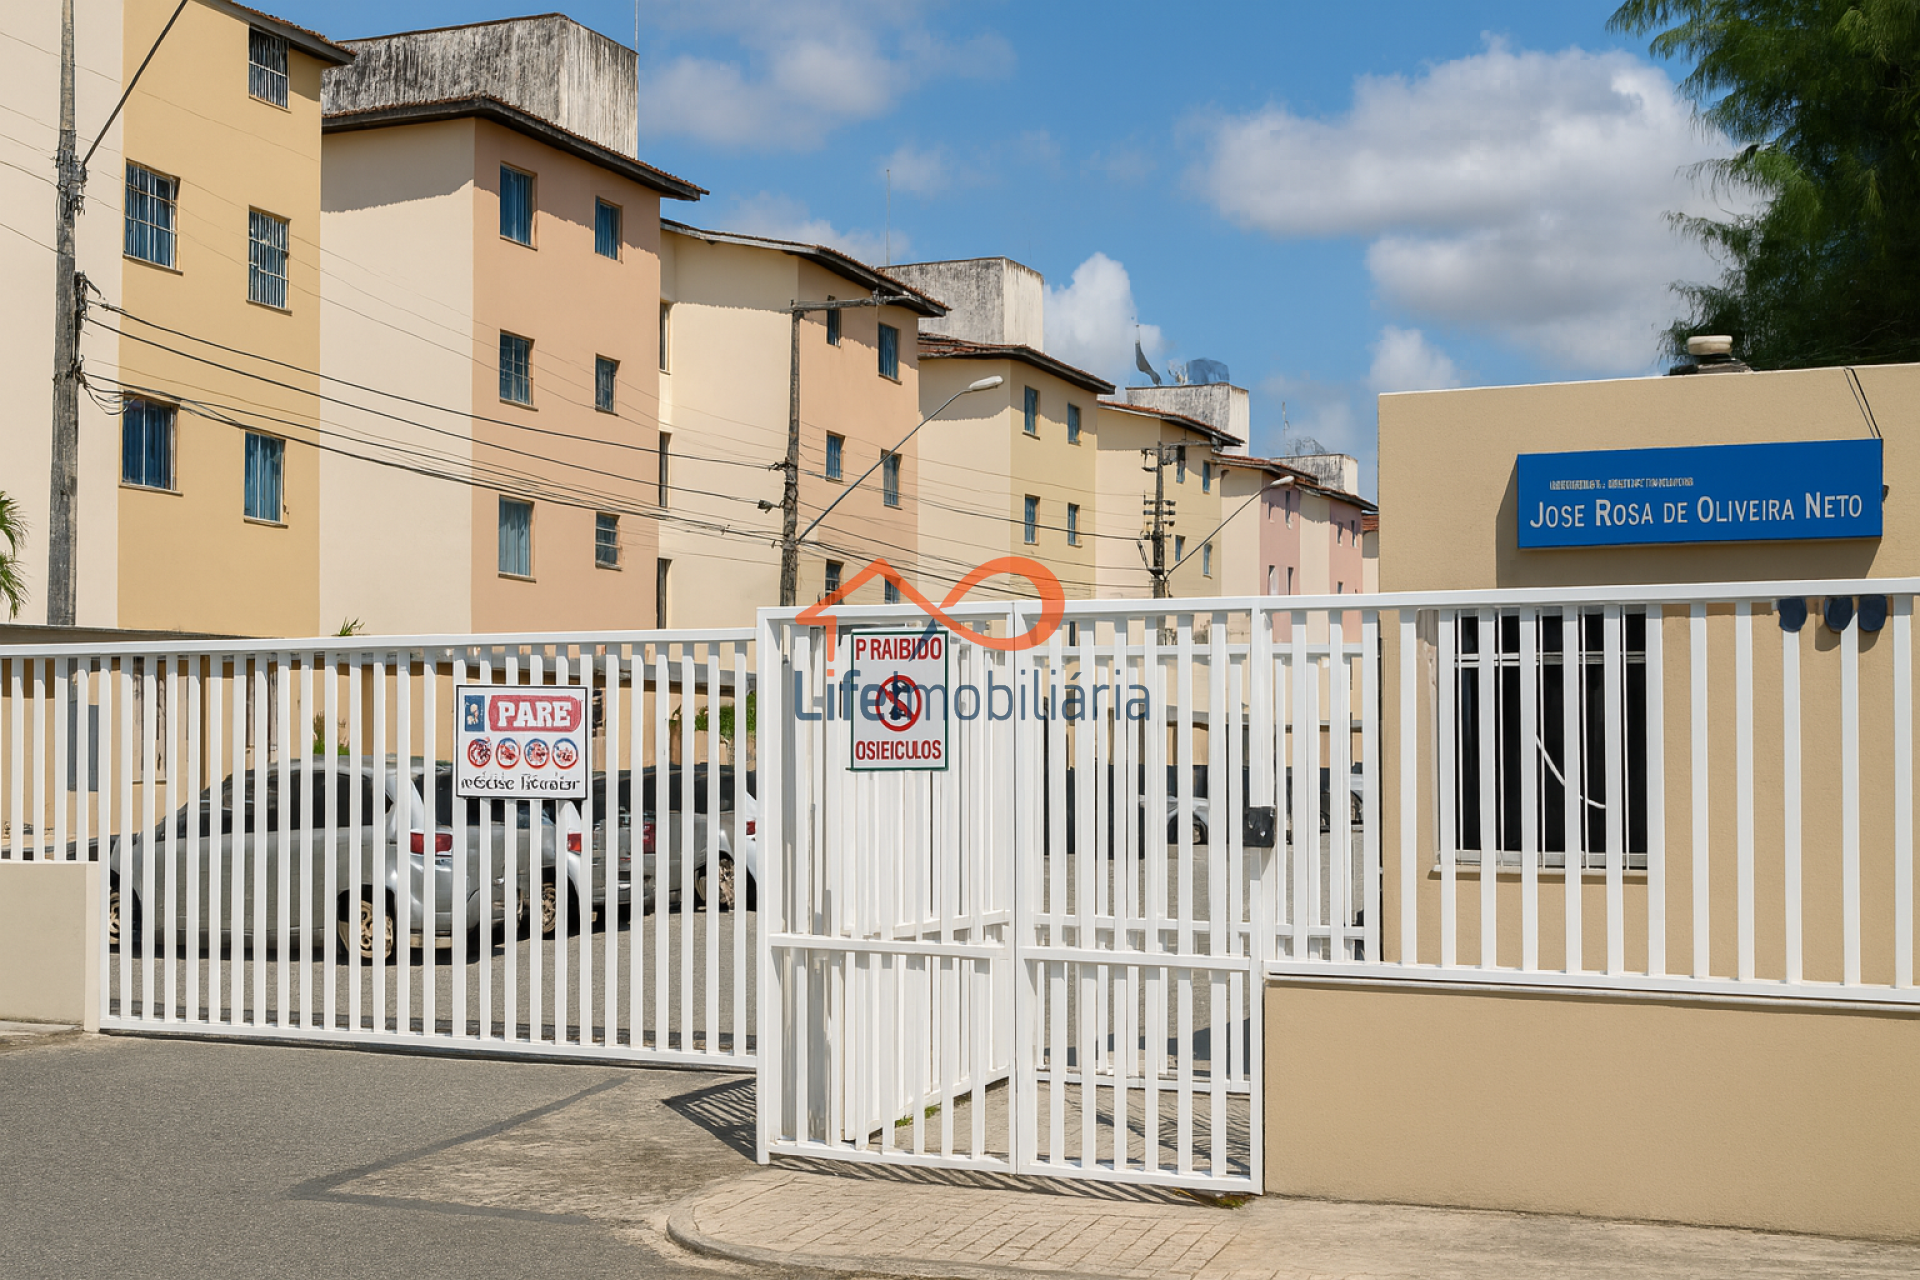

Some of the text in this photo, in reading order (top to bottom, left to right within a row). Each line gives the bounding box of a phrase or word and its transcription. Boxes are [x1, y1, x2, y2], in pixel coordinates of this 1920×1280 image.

[1595, 499, 1654, 526] ROSA
[1697, 496, 1795, 524] OLIVEIRA
[1805, 491, 1863, 519] NETO
[497, 701, 572, 727] PARE
